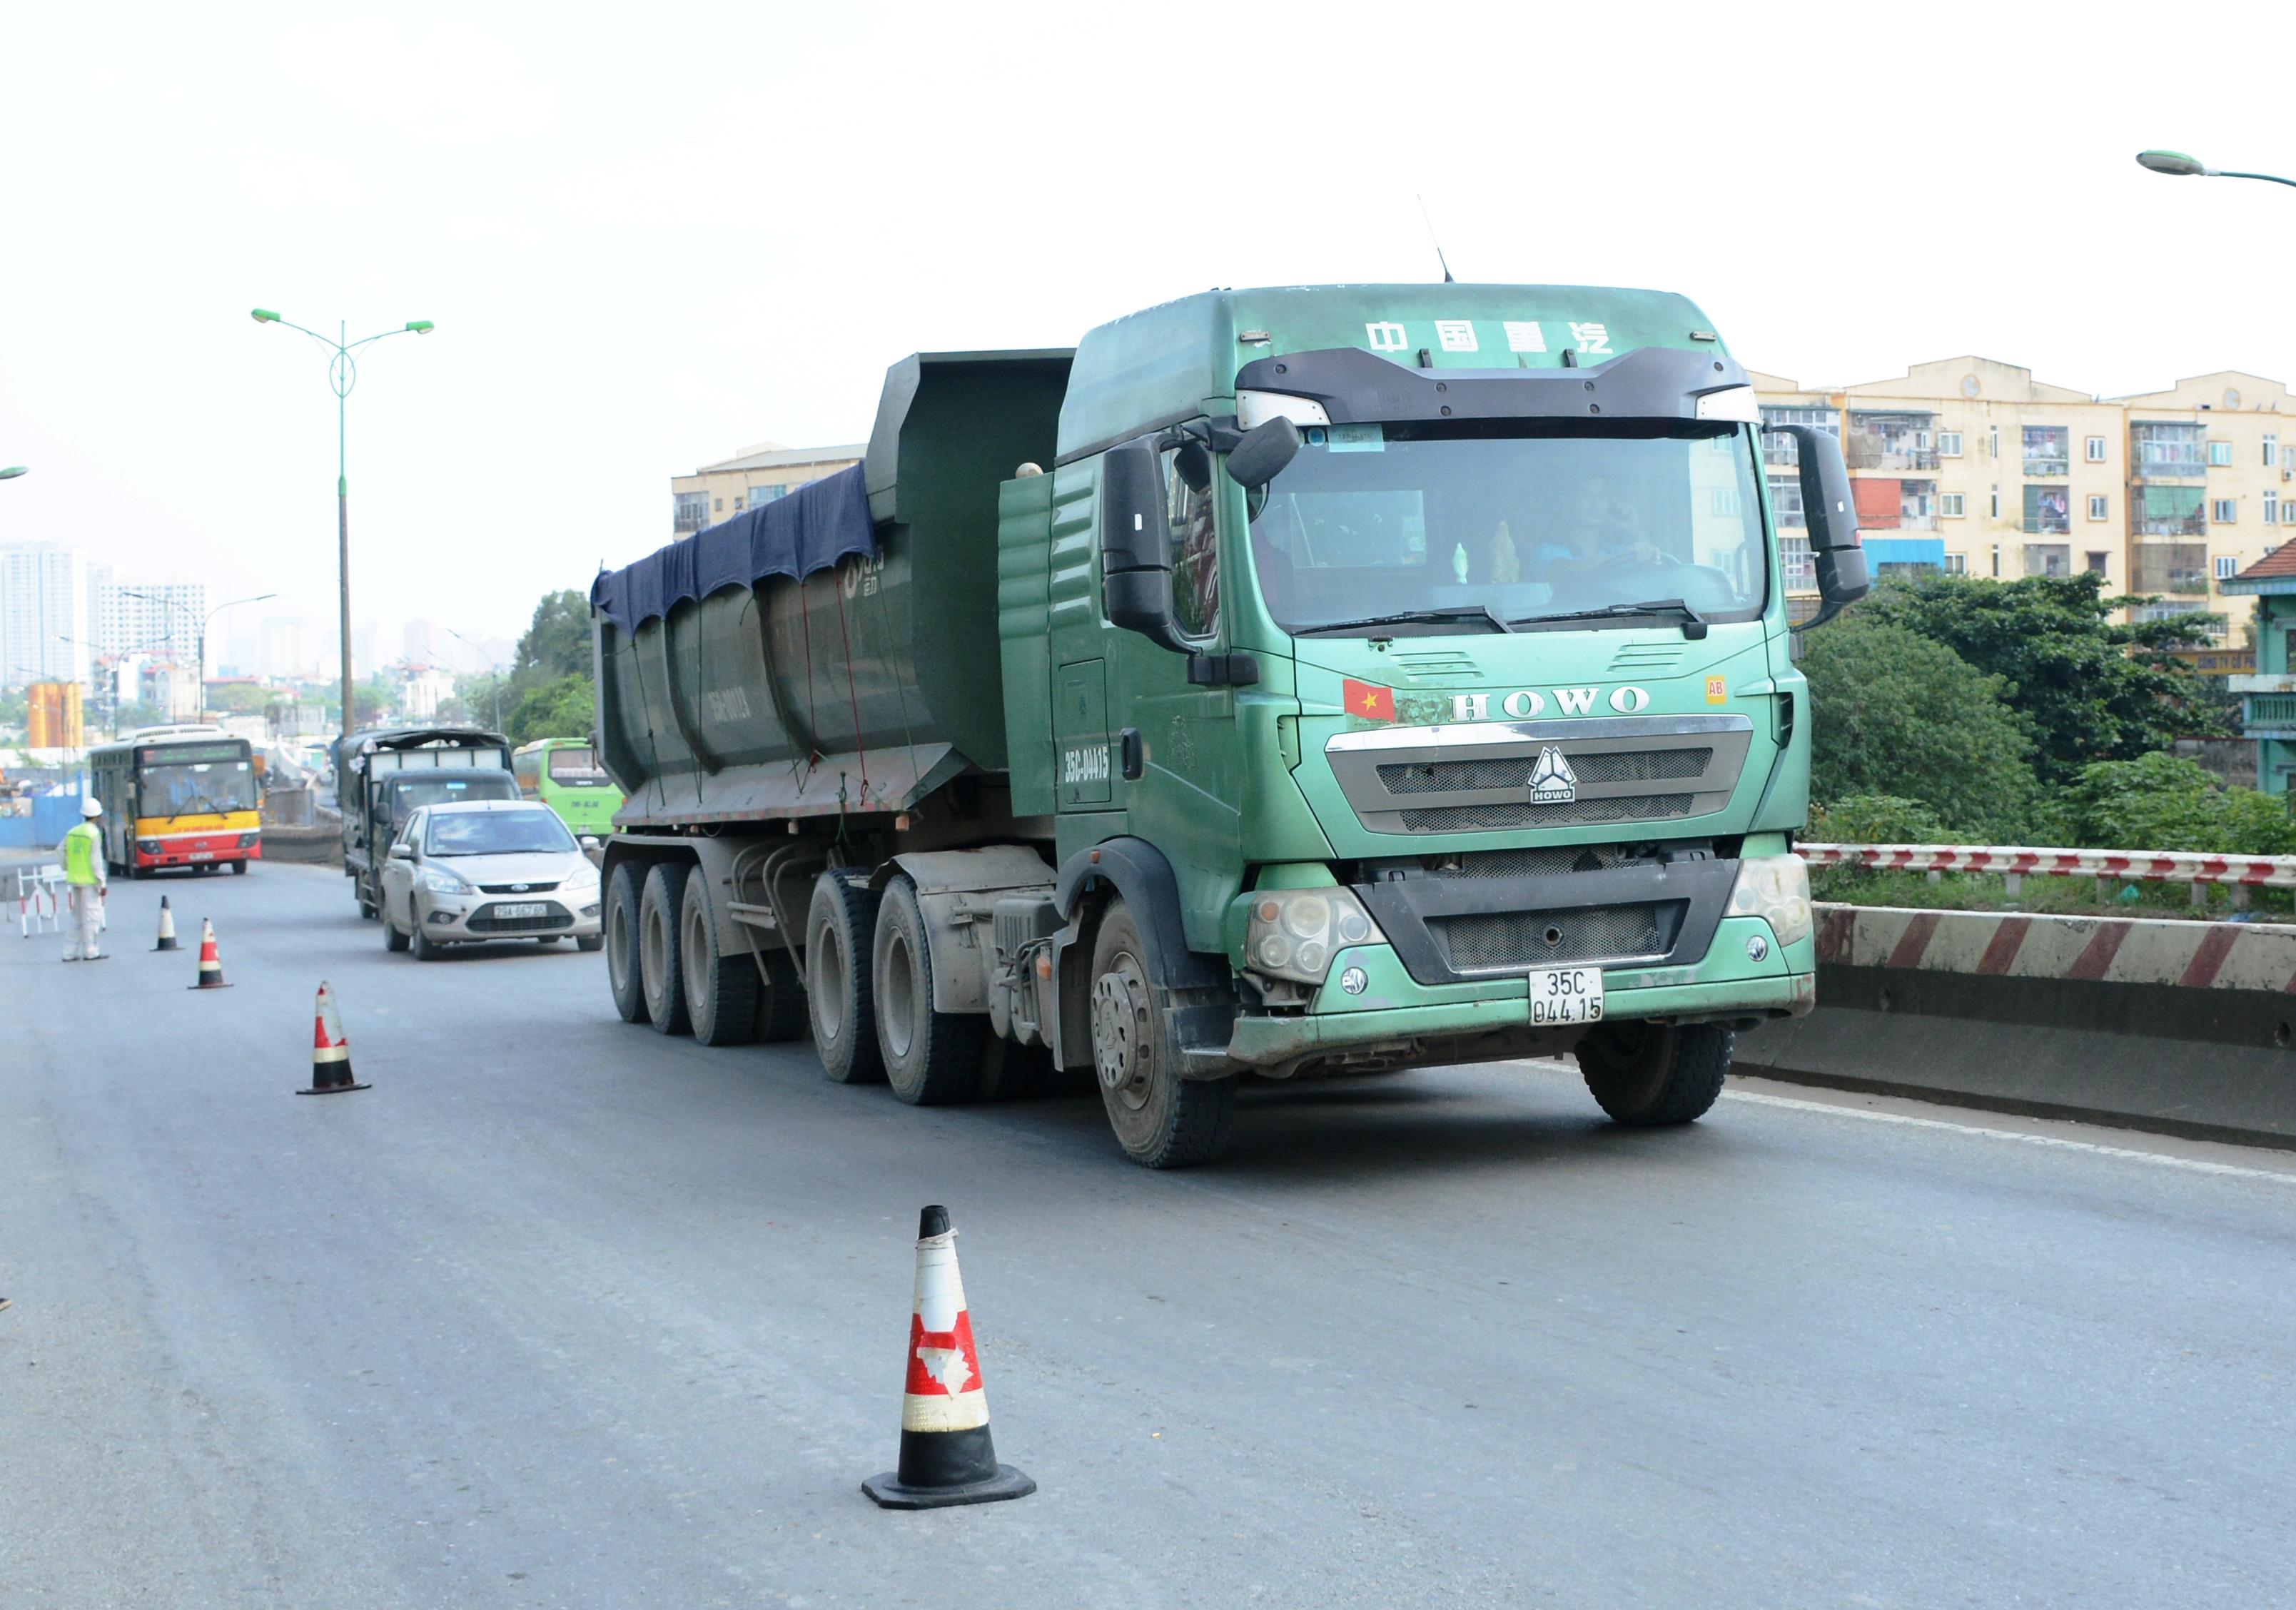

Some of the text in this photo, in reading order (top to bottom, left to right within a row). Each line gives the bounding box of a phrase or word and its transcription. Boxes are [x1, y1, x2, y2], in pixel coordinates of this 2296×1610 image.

[1365, 321, 1613, 353] 中国重汽
[1708, 681, 1724, 695] AB
[1447, 686, 1650, 723] HOWO
[1065, 746, 1108, 783] 35C-04415
[1534, 789, 1572, 801] HOWO
[1547, 971, 1586, 996] 35C
[1533, 996, 1602, 1023] 044.15
